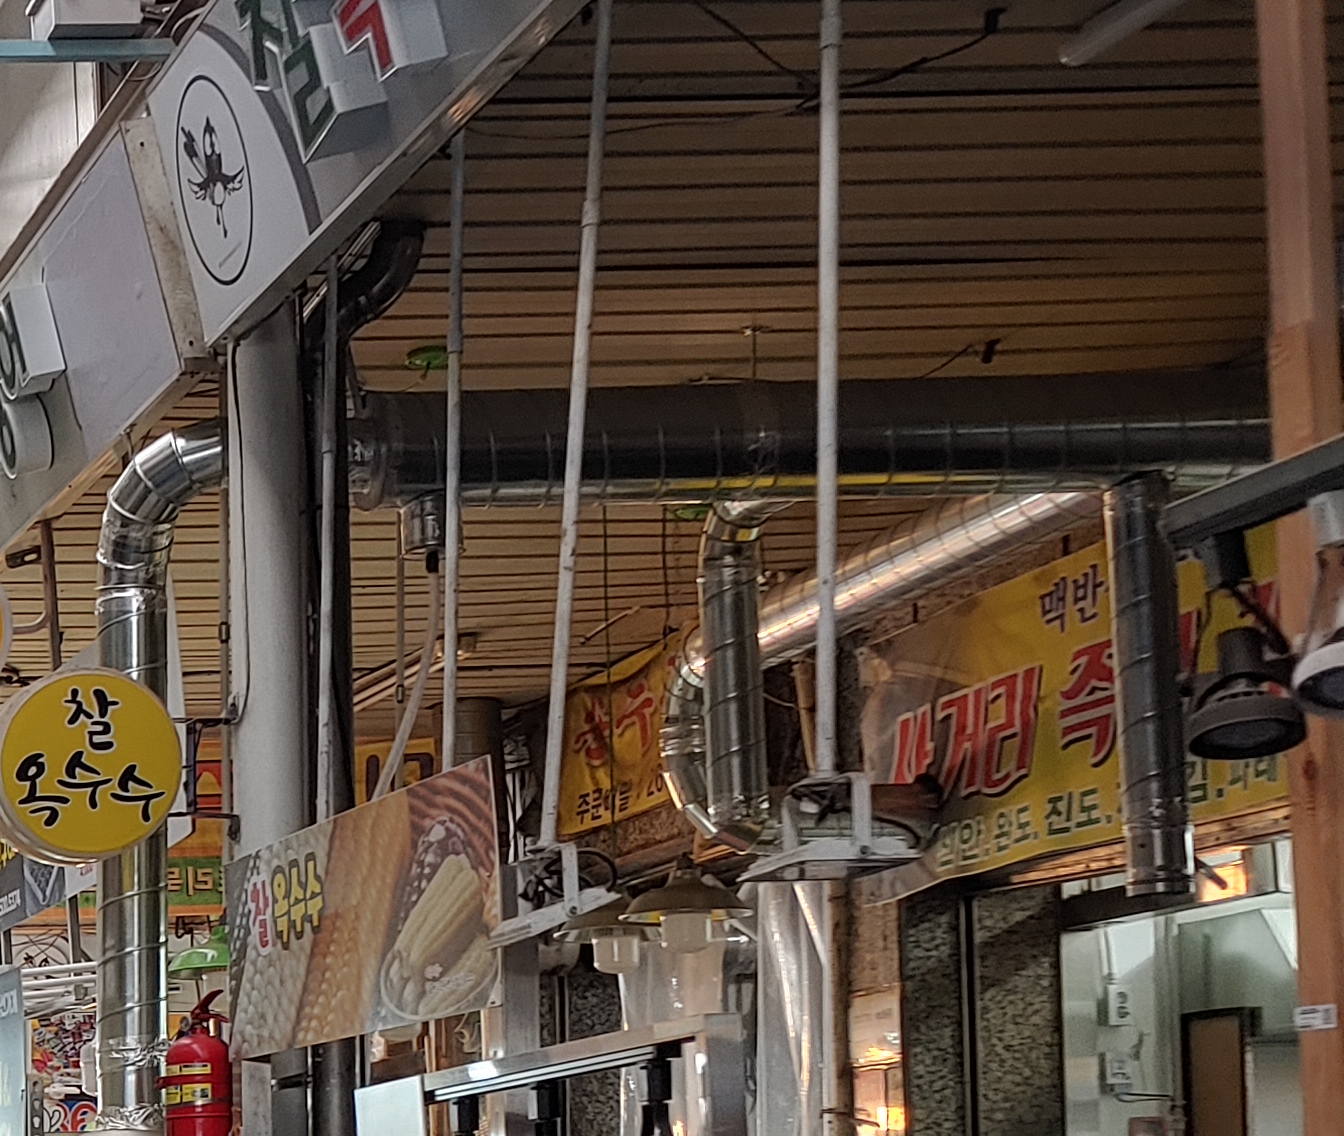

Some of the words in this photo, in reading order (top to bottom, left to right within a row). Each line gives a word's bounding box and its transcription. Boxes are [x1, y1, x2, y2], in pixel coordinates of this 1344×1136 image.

[64, 689, 120, 748] 찰
[14, 750, 167, 828] 옥수수
[247, 864, 272, 955] 찰
[272, 851, 323, 950] 옥수수
